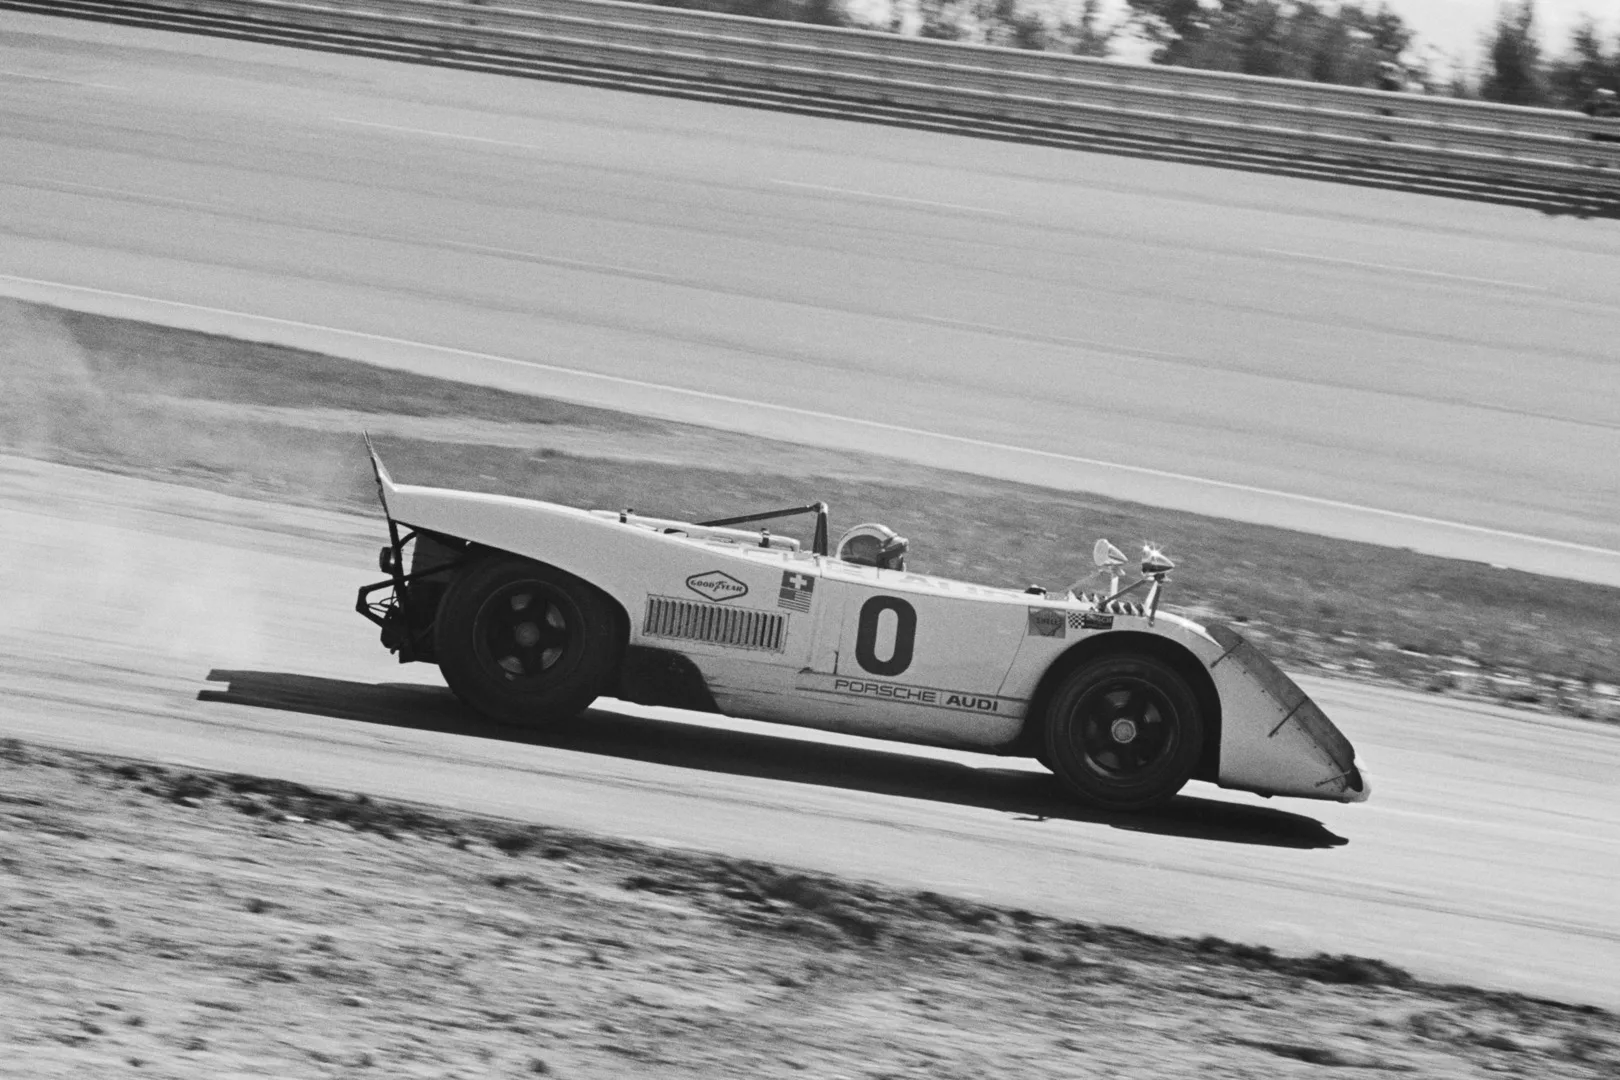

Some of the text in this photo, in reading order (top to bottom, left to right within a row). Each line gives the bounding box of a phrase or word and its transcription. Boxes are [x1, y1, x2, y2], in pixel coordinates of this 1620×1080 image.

[855, 595, 918, 677] 0
[834, 679, 999, 712] PORSCHE AUDI
